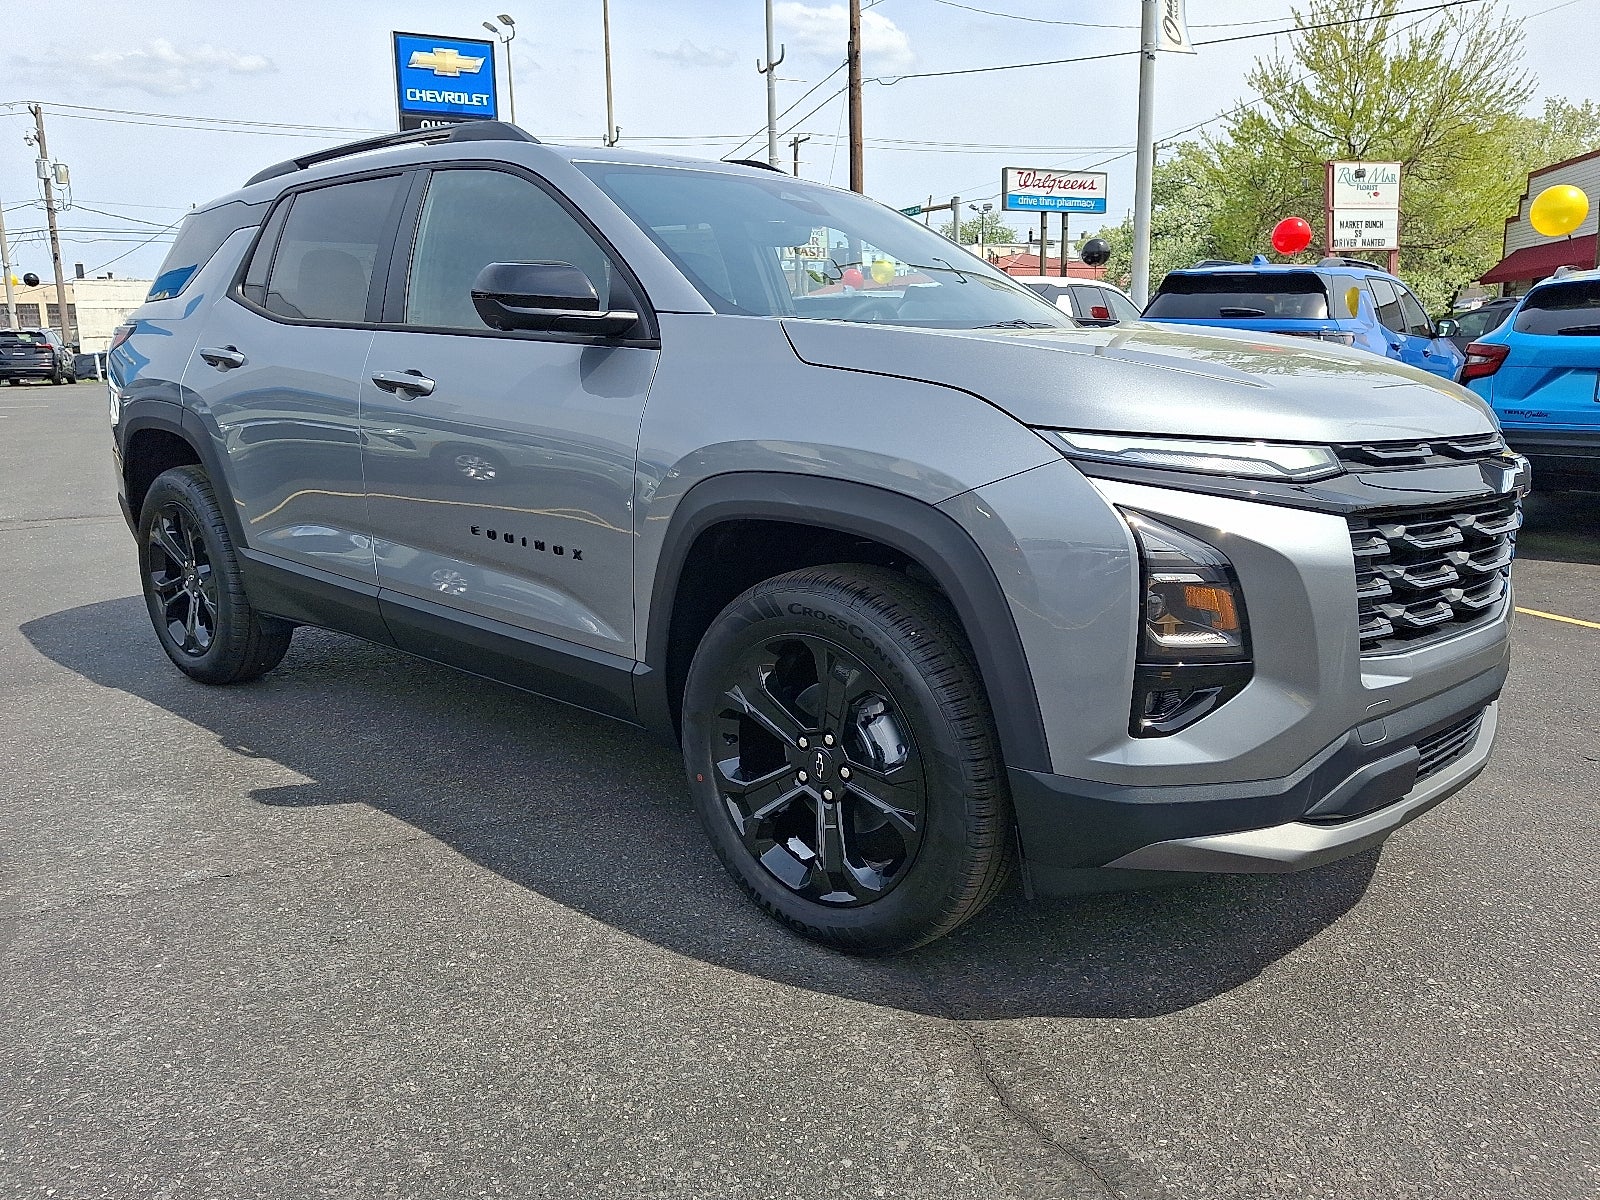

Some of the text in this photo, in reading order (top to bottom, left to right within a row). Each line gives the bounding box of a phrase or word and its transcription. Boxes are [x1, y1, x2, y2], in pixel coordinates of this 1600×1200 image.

[406, 88, 489, 106] CHEVROLET
[1017, 170, 1098, 195] Walgreens
[1018, 196, 1096, 210] drive thru pharmacy
[1334, 239, 1357, 247] DRIVER
[470, 524, 583, 561] EQUINOX
